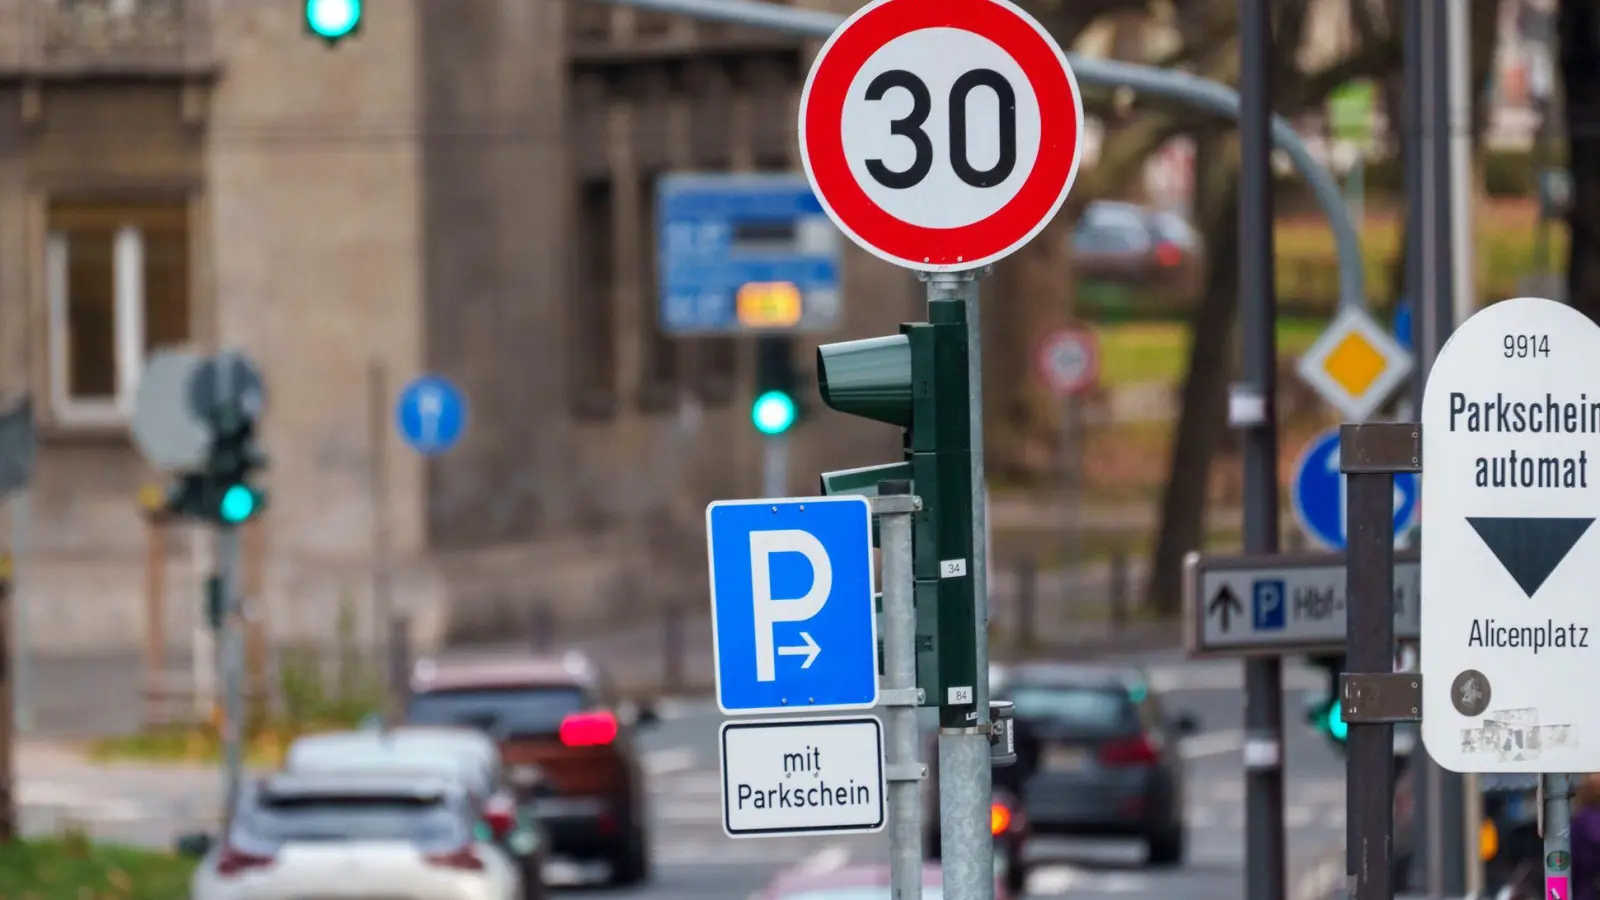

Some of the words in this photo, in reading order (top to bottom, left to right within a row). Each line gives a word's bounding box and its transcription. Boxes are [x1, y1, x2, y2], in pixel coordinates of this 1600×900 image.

[864, 68, 1017, 189] 30
[1503, 334, 1550, 358] 9914
[1450, 392, 1600, 433] Parkschein
[1475, 449, 1587, 488] automat
[947, 563, 961, 574] 34
[749, 529, 833, 682] P
[1468, 618, 1589, 654] Alicenplatz
[955, 690, 968, 701] 84
[783, 745, 821, 772] mit
[738, 779, 870, 810] Parkschein
